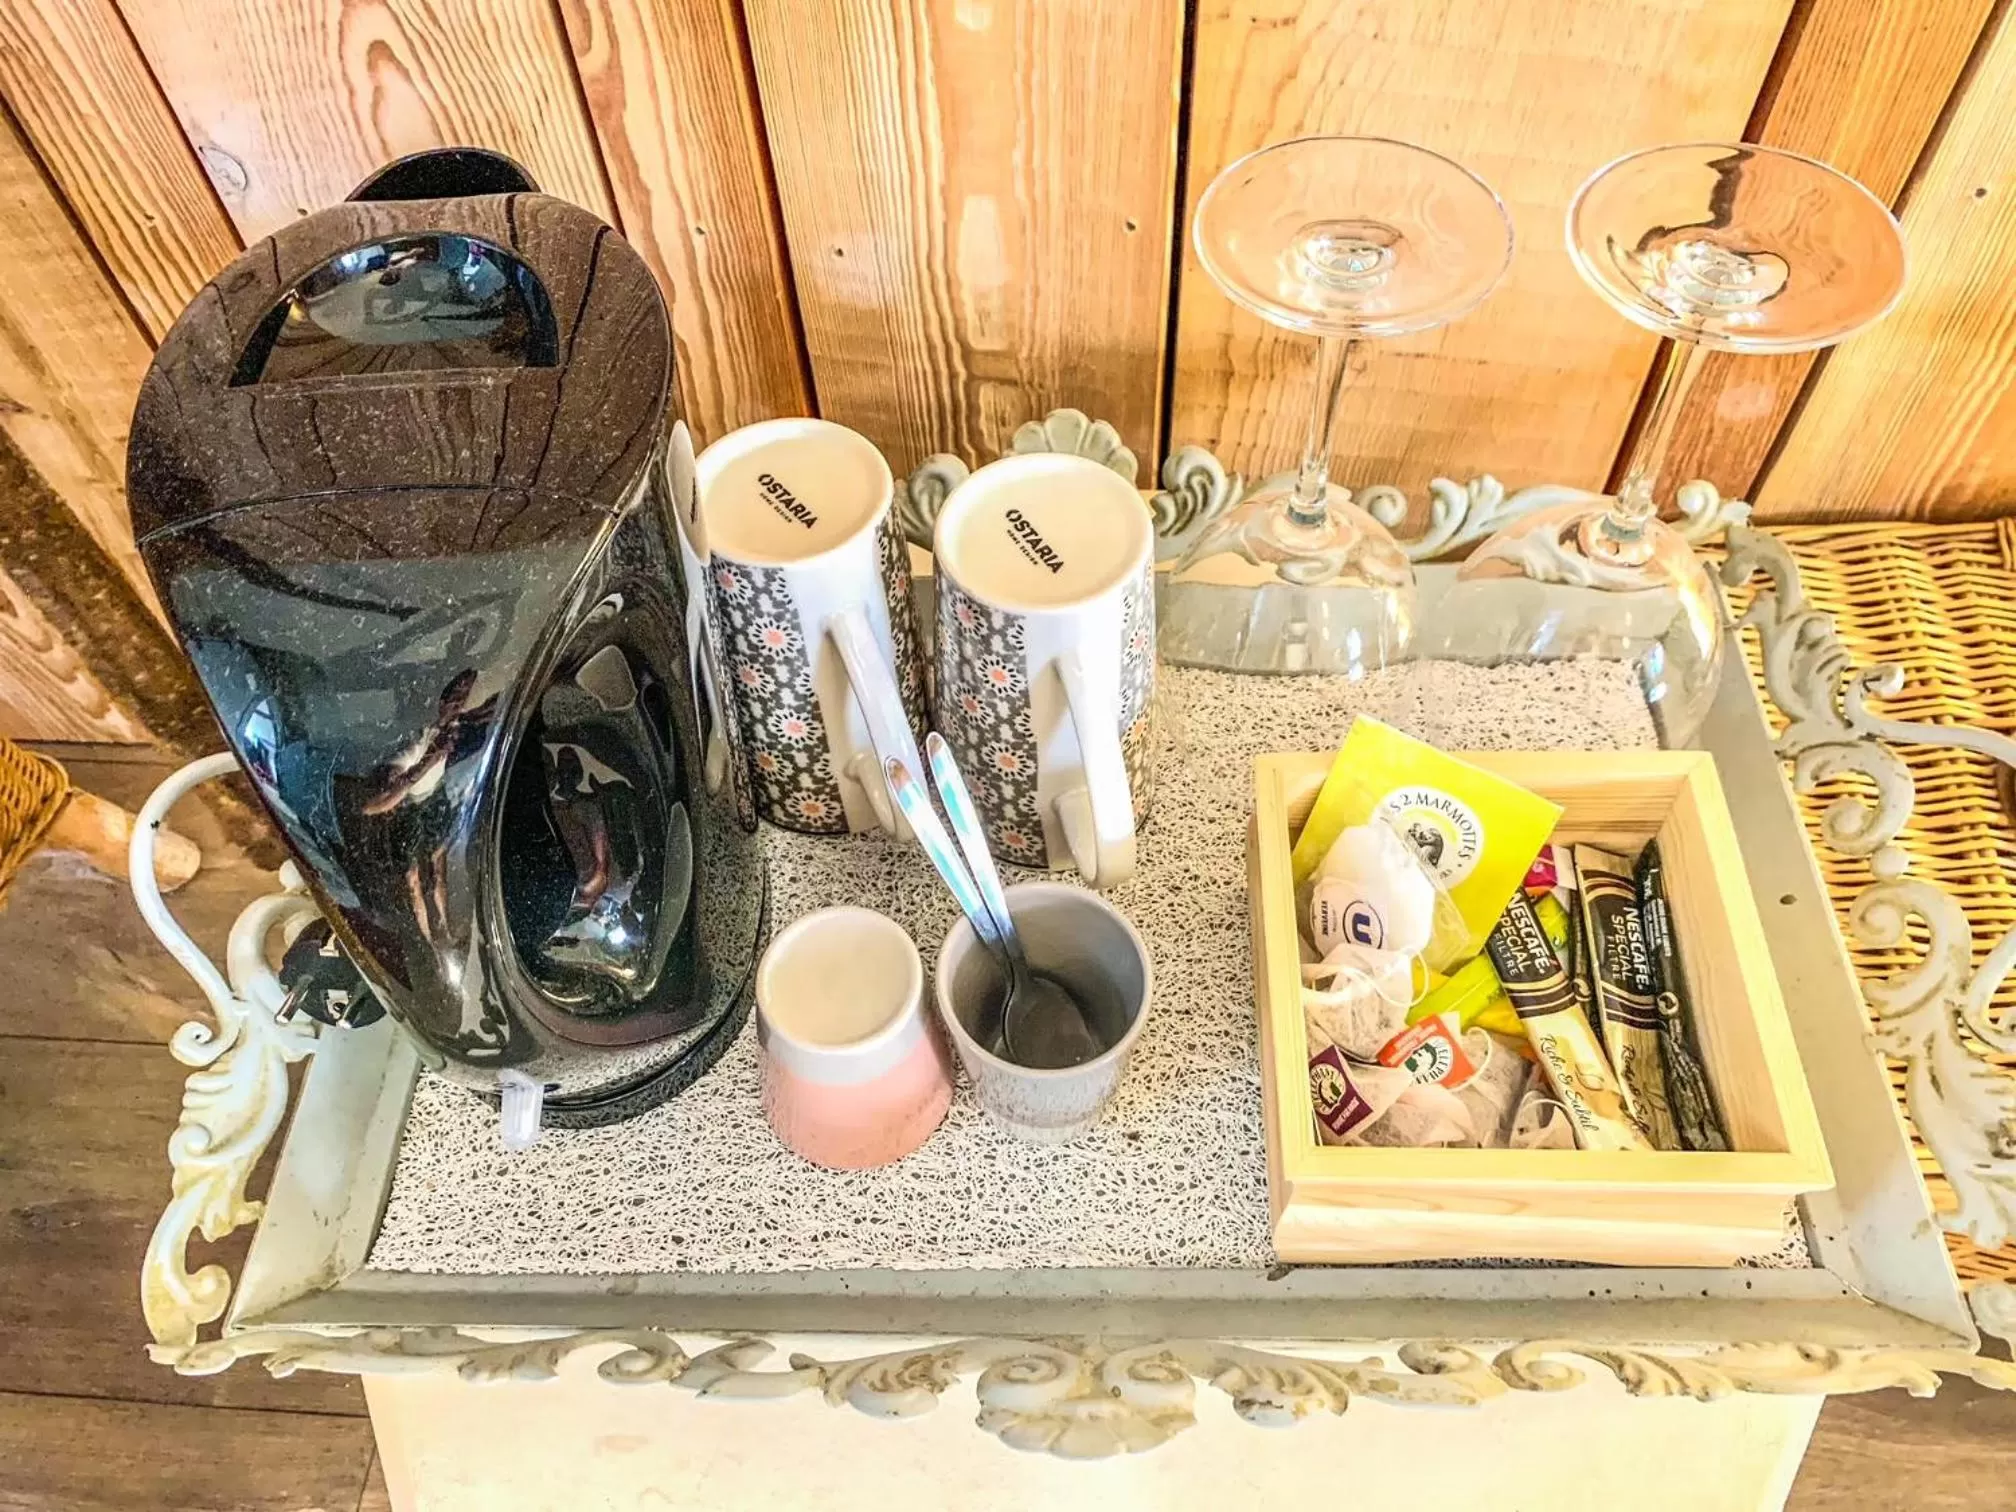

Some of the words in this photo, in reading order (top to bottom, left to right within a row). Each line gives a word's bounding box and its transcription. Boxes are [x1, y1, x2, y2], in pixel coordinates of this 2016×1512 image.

[758, 474, 818, 529] OSTARIA
[1006, 509, 1065, 574] OSTARIA
[1400, 793, 1412, 806] 2
[1500, 909, 1532, 973] PECIAL
[1606, 935, 1621, 980] FILTRE
[1611, 914, 1633, 981] SPECIAL
